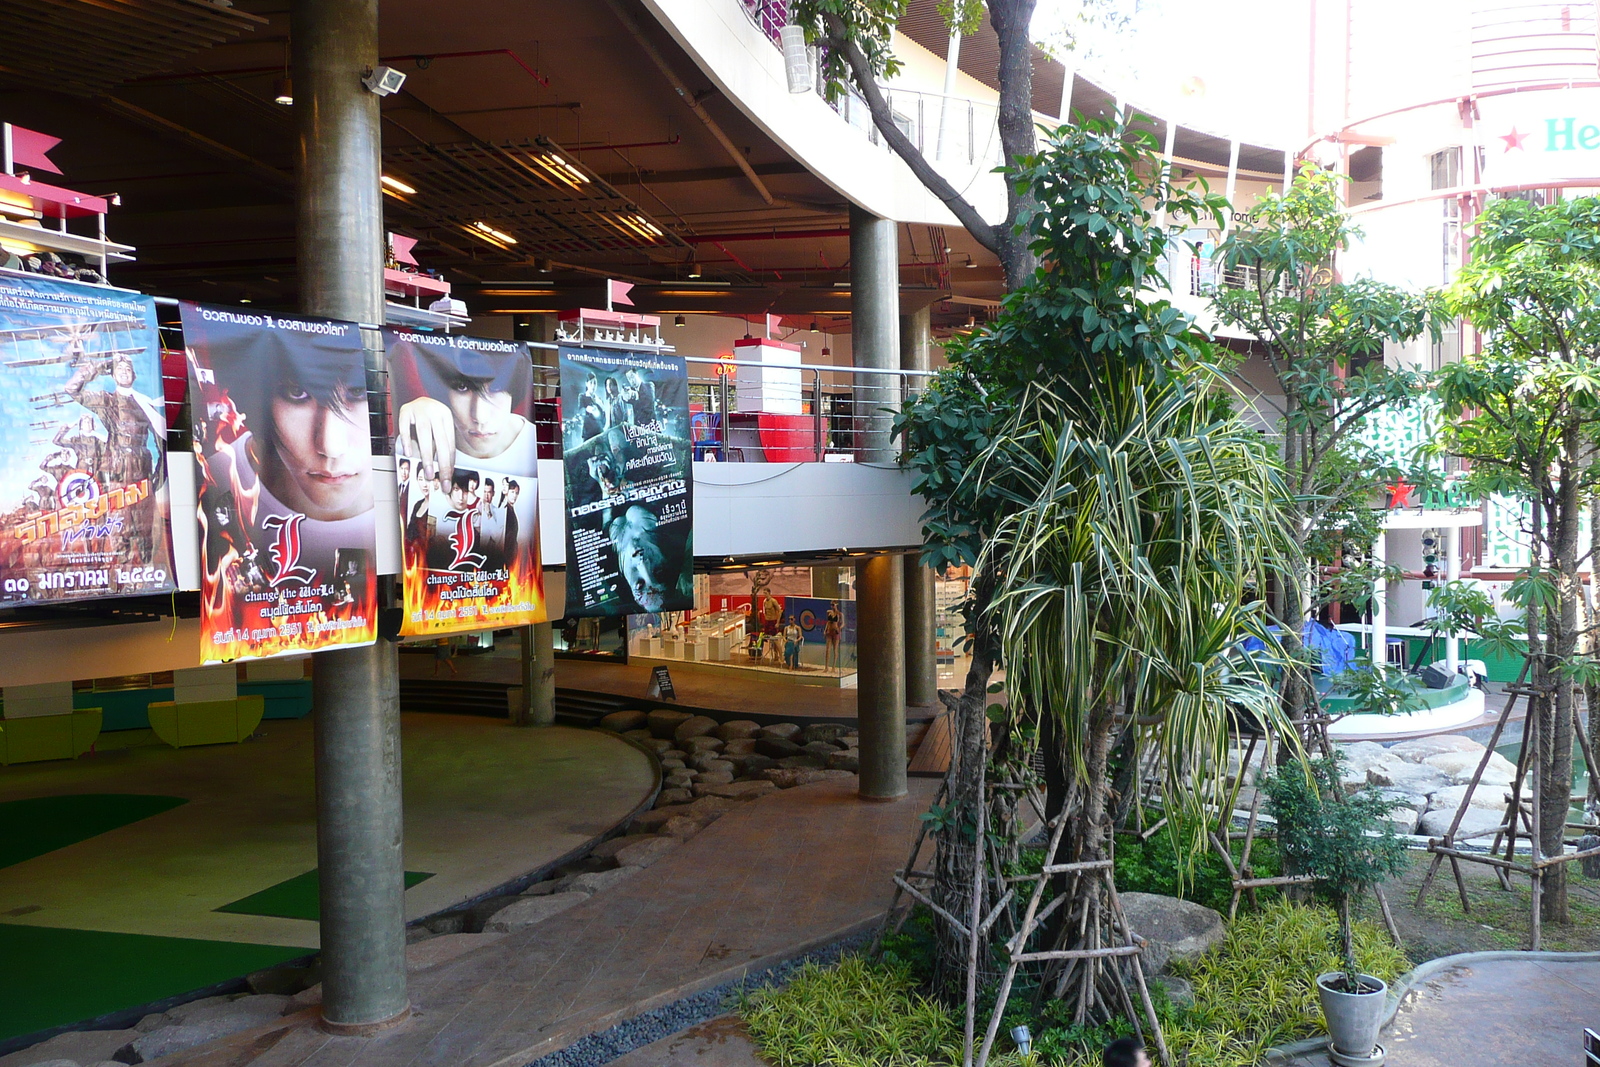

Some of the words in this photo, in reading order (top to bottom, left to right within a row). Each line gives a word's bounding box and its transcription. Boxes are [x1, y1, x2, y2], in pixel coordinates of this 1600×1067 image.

[14, 479, 150, 545] รักสยาม
[38, 569, 109, 589] มกราคม
[427, 574, 458, 586] change
[460, 571, 475, 583] the
[245, 591, 278, 603] change
[282, 588, 297, 599] the
[423, 609, 435, 620] 14
[458, 605, 478, 617] 2551
[214, 627, 235, 644] วันที่
[236, 629, 250, 642] 14
[279, 622, 302, 637] 2551
